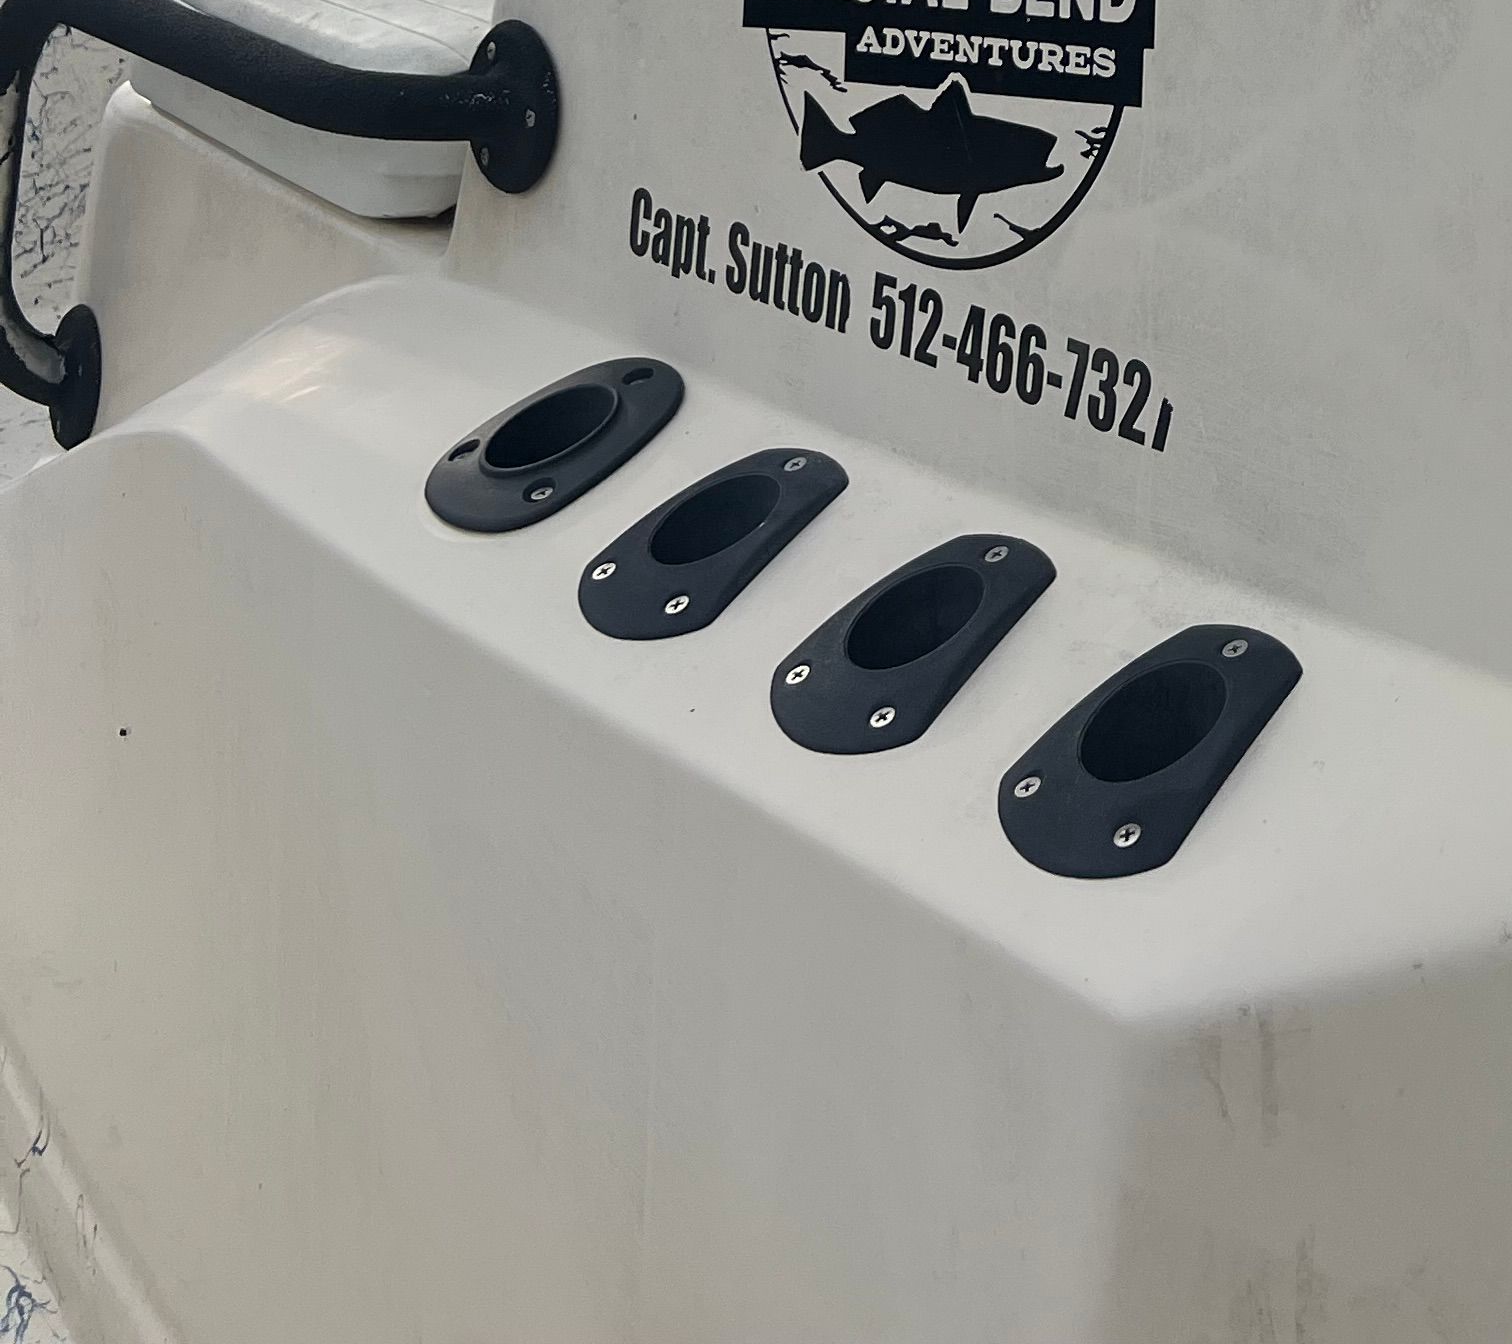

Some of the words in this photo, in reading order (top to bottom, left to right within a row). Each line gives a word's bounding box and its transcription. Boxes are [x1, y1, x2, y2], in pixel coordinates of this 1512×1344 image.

[855, 25, 1117, 80] ADVENTURES
[629, 187, 716, 285] Capt.
[725, 221, 851, 333] Sutton
